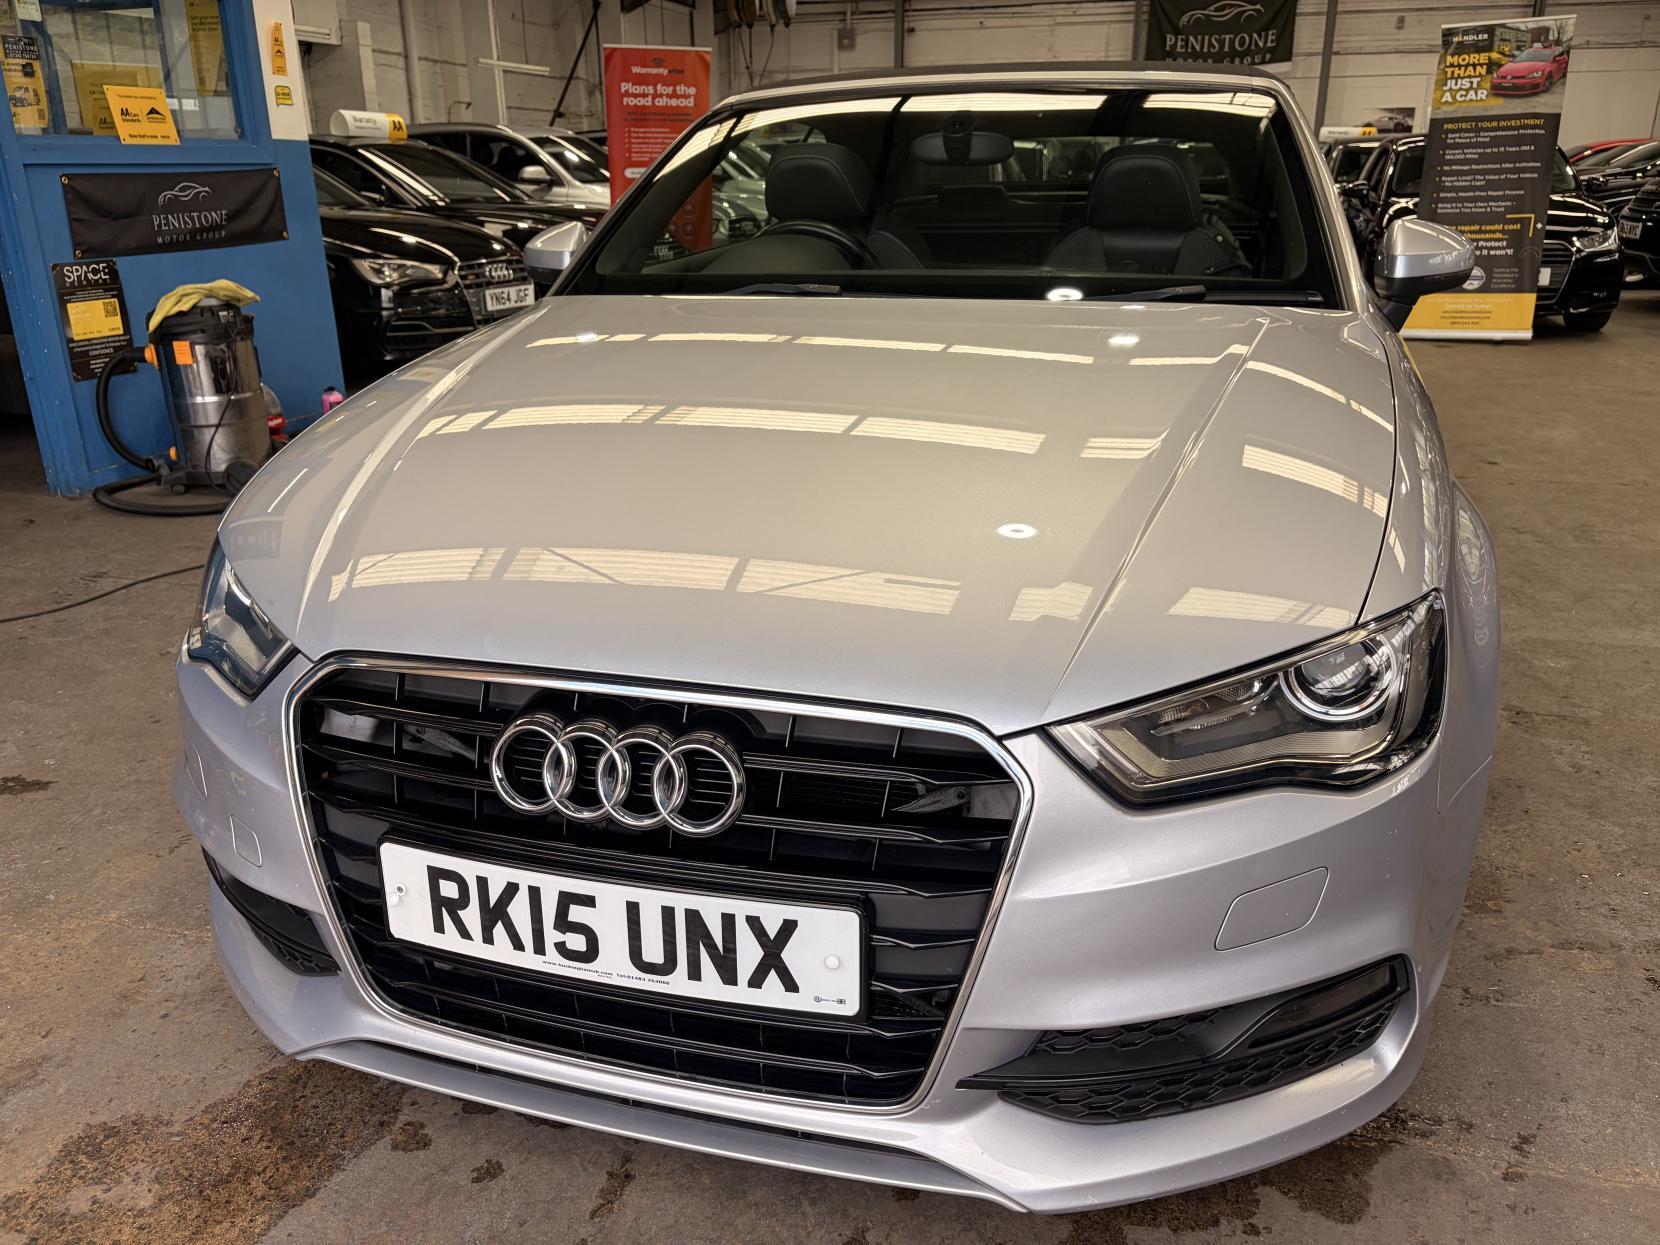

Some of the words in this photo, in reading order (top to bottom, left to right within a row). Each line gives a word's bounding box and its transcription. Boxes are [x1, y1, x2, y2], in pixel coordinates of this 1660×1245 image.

[1165, 30, 1277, 52] PENISTONE
[1224, 53, 1272, 64] GROUP
[1446, 53, 1490, 66] MORE
[1445, 66, 1488, 78] THAN
[620, 82, 654, 94] Plans
[656, 83, 674, 94] for
[676, 84, 697, 96] the
[1443, 78, 1482, 90] JUST
[623, 96, 652, 106] road
[655, 96, 697, 107] ahead.
[1440, 92, 1452, 102] A
[1456, 90, 1488, 102] CAR
[121, 107, 130, 117] AA
[392, 120, 404, 132] AA
[1478, 120, 1498, 128] YOUR
[1500, 119, 1544, 128] INVESTMENT
[152, 210, 228, 231] PENISTONE
[1457, 224, 1480, 232] repair
[1481, 223, 1504, 231] could
[157, 234, 190, 244] MOTOR
[196, 230, 226, 240] GROUP
[1489, 248, 1514, 256] won't!
[64, 264, 110, 282] SPACE
[490, 290, 512, 306] YN64
[514, 288, 529, 304] JGF
[426, 864, 600, 964] RK15
[626, 900, 800, 994] UNX
